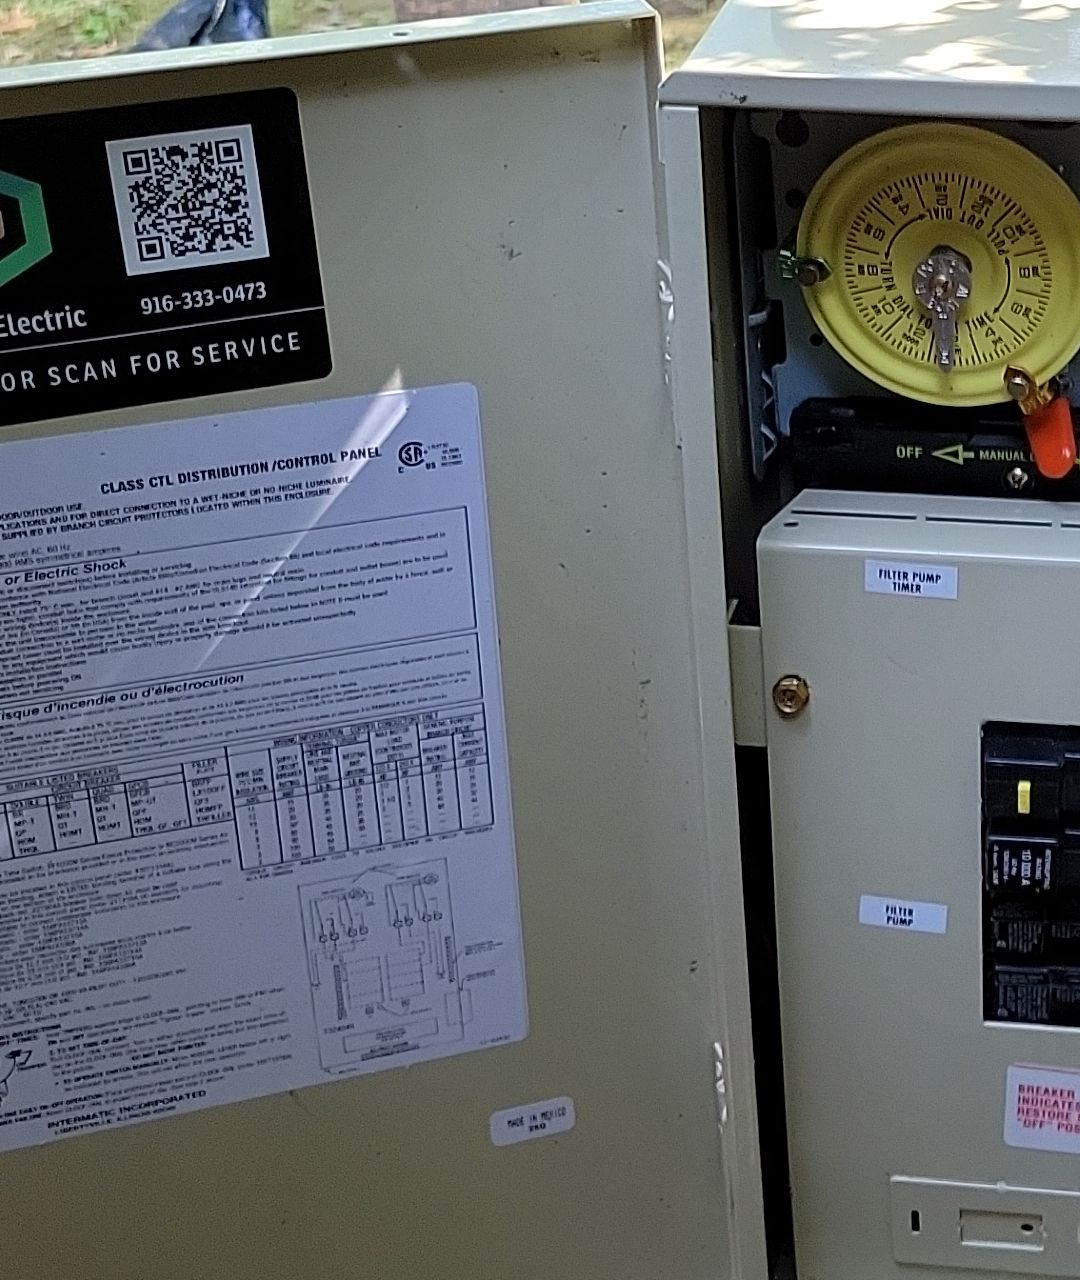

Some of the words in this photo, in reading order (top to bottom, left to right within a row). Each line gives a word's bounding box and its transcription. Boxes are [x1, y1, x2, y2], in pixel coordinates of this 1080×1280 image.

[926, 207, 953, 220] DIAL
[960, 210, 985, 230] OUT
[140, 282, 267, 316] 916-333-0473
[880, 261, 897, 291] TURN
[892, 295, 913, 318] DIAL
[0, 309, 87, 337] Electric
[907, 322, 926, 340] 12
[965, 312, 994, 332] TIME
[985, 327, 996, 338] 4
[1, 370, 36, 392] OR
[48, 358, 118, 387] SCAN
[129, 349, 181, 376] FOR
[191, 331, 301, 367] SERVICE
[896, 445, 922, 459] OFF
[979, 448, 1026, 462] MANUAL
[100, 478, 145, 495] CLASS
[149, 475, 174, 488] CTL
[178, 462, 270, 484] DISTRIBUTION
[271, 452, 337, 472] /CONTROL
[340, 446, 383, 461] PANEL
[0, 519, 48, 531] LICATIONS
[70, 513, 87, 521] FOR
[90, 509, 120, 519] DIRECT
[123, 500, 177, 514] CONNECTION
[180, 498, 191, 507] TO
[47, 526, 58, 535] BY
[60, 521, 96, 533] BRANCH
[99, 517, 131, 527] CIRCUIT
[134, 509, 189, 522] PROTECTORS
[232, 499, 261, 509] WITHIN
[264, 495, 283, 504] THIS
[4, 575, 21, 586] or
[24, 565, 79, 582] Electric
[83, 559, 127, 574] Shock
[878, 568, 909, 581] FILTER
[912, 572, 942, 584] PUMP
[892, 582, 922, 594] TIMER
[0, 706, 40, 720] isque
[44, 694, 116, 713] d'incendie
[120, 691, 138, 702] ou
[142, 674, 244, 698] d'électrocution
[885, 905, 913, 917] FILTER
[886, 916, 913, 927] PUMP
[1018, 1084, 1075, 1099] BREAKER
[47, 1104, 116, 1129] INTERMATIC
[119, 1090, 207, 1115] INCORPORATED
[529, 1114, 537, 1124] IN
[541, 1106, 567, 1120] MEXICO
[1017, 1107, 1072, 1121] RESTORE
